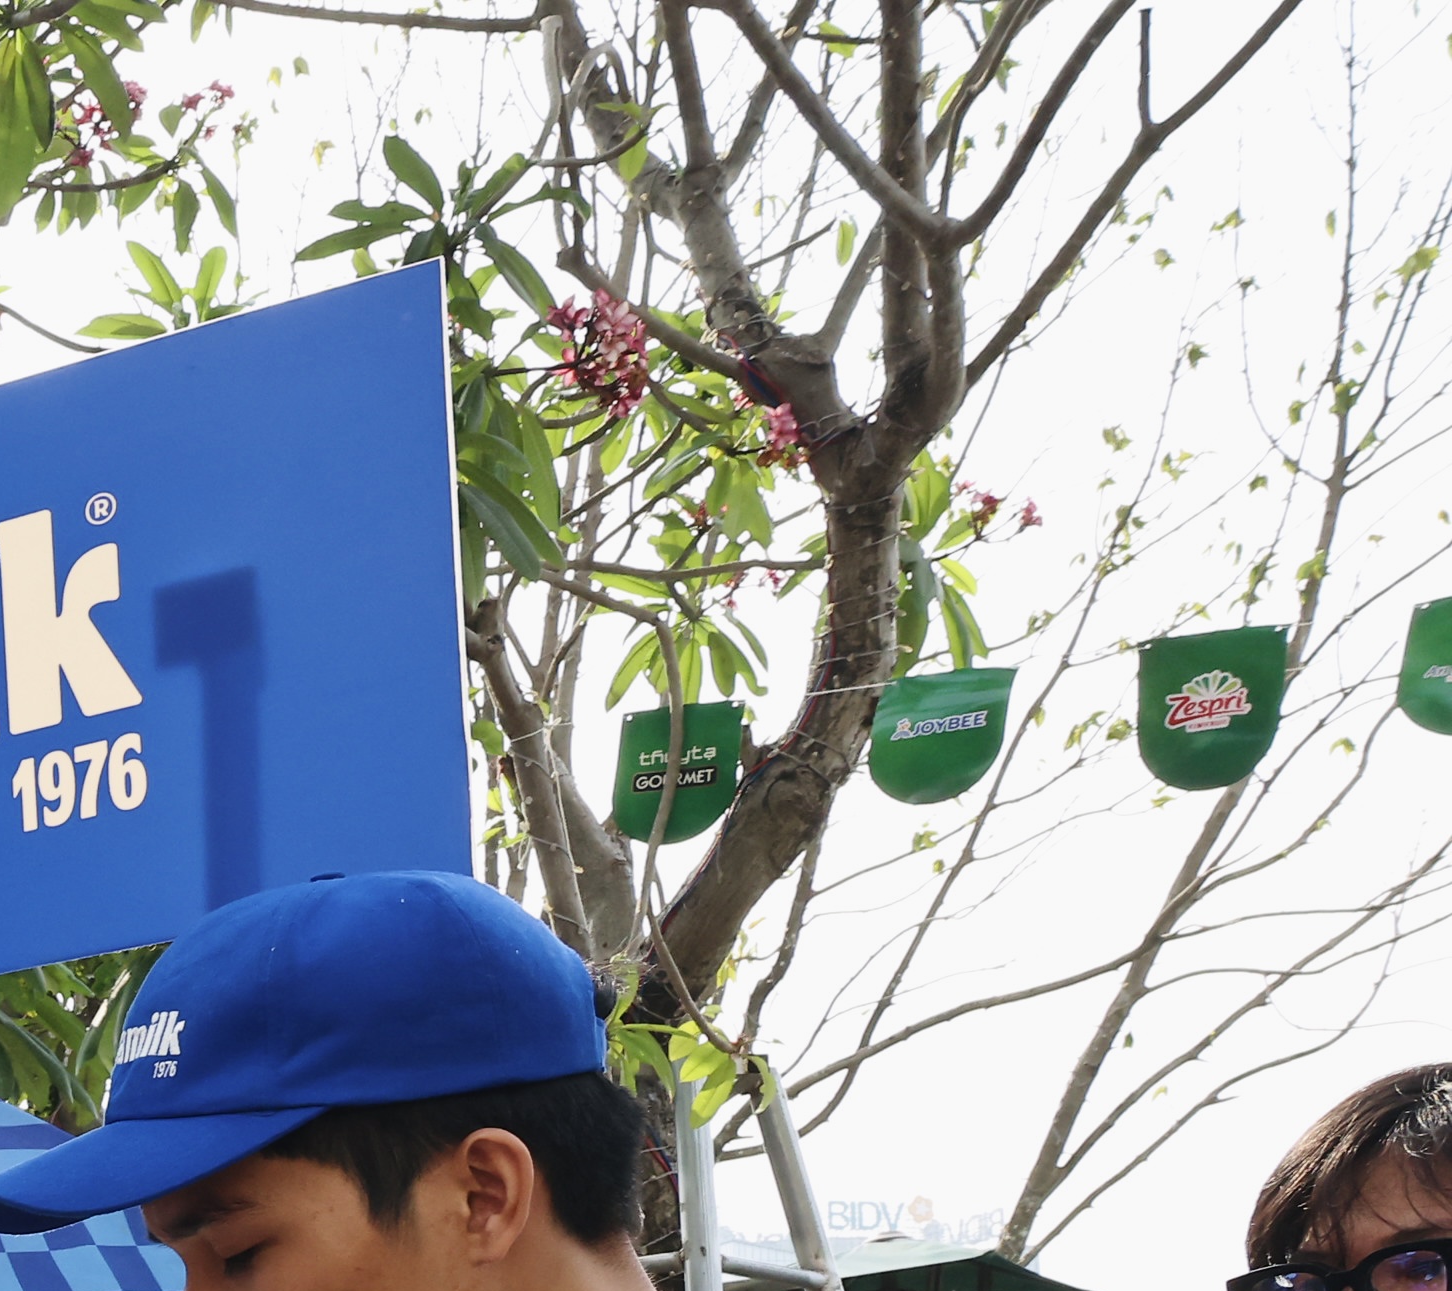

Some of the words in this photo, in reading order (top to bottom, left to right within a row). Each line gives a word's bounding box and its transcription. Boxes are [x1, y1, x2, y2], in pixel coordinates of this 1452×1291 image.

[913, 711, 987, 737] JOYBEE
[1168, 690, 1246, 726] Zespri
[12, 733, 148, 833] 1976
[634, 768, 714, 790] GORMET
[114, 1010, 186, 1065] amilk
[152, 1061, 178, 1079] 1976
[828, 1200, 904, 1232] BIDV
